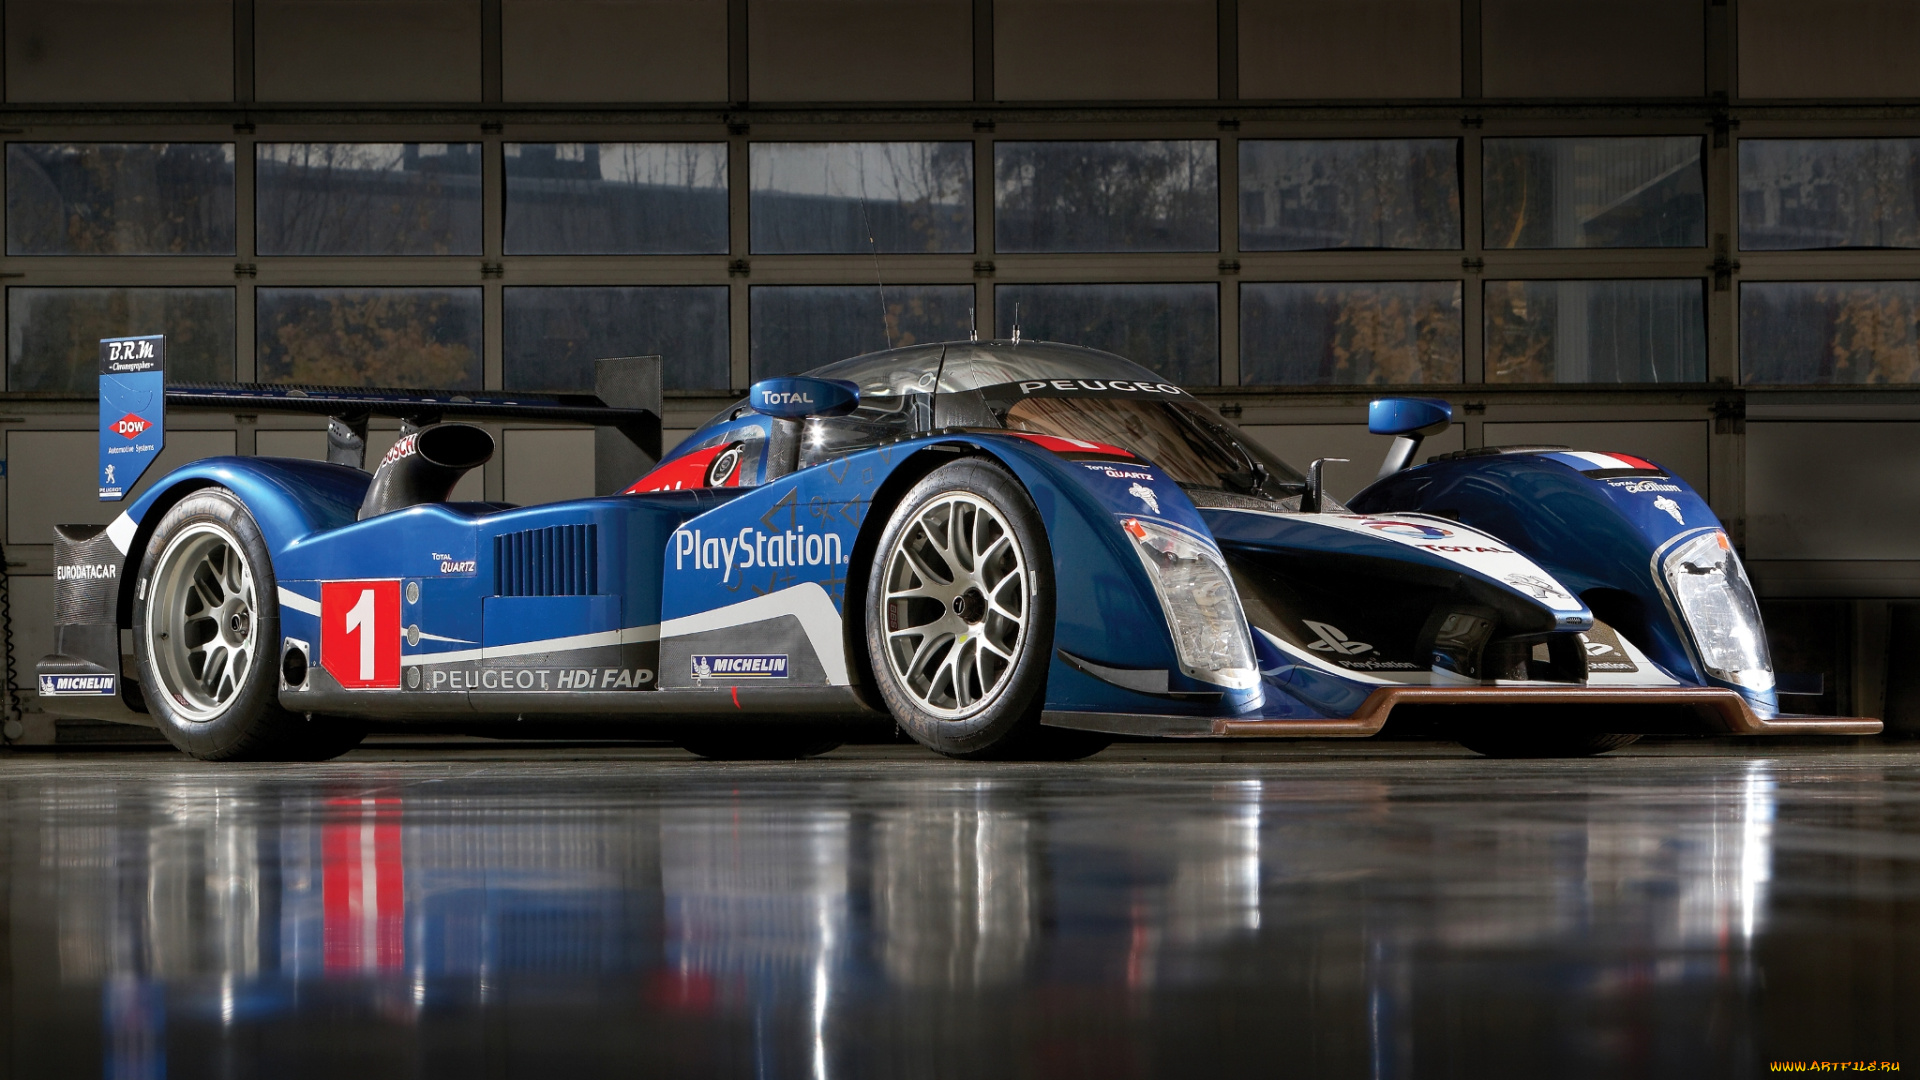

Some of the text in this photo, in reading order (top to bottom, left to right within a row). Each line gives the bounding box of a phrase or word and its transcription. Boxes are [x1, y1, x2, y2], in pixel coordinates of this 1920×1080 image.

[1019, 379, 1190, 397] PEUGEO
[761, 390, 814, 405] TOTAL
[135, 444, 154, 453] Systems
[377, 433, 417, 472] OSCH
[1105, 469, 1154, 481] QUARTZ
[431, 552, 452, 561] TOTAL
[676, 525, 842, 583] PlayStation
[57, 564, 116, 580] EURODATACAR
[440, 561, 475, 573] QUARTZ
[345, 589, 375, 680] 1
[713, 659, 786, 671] MICHELIN
[56, 677, 114, 689] MICHELIN
[432, 669, 654, 689] PEUGEOT HDi FAP
